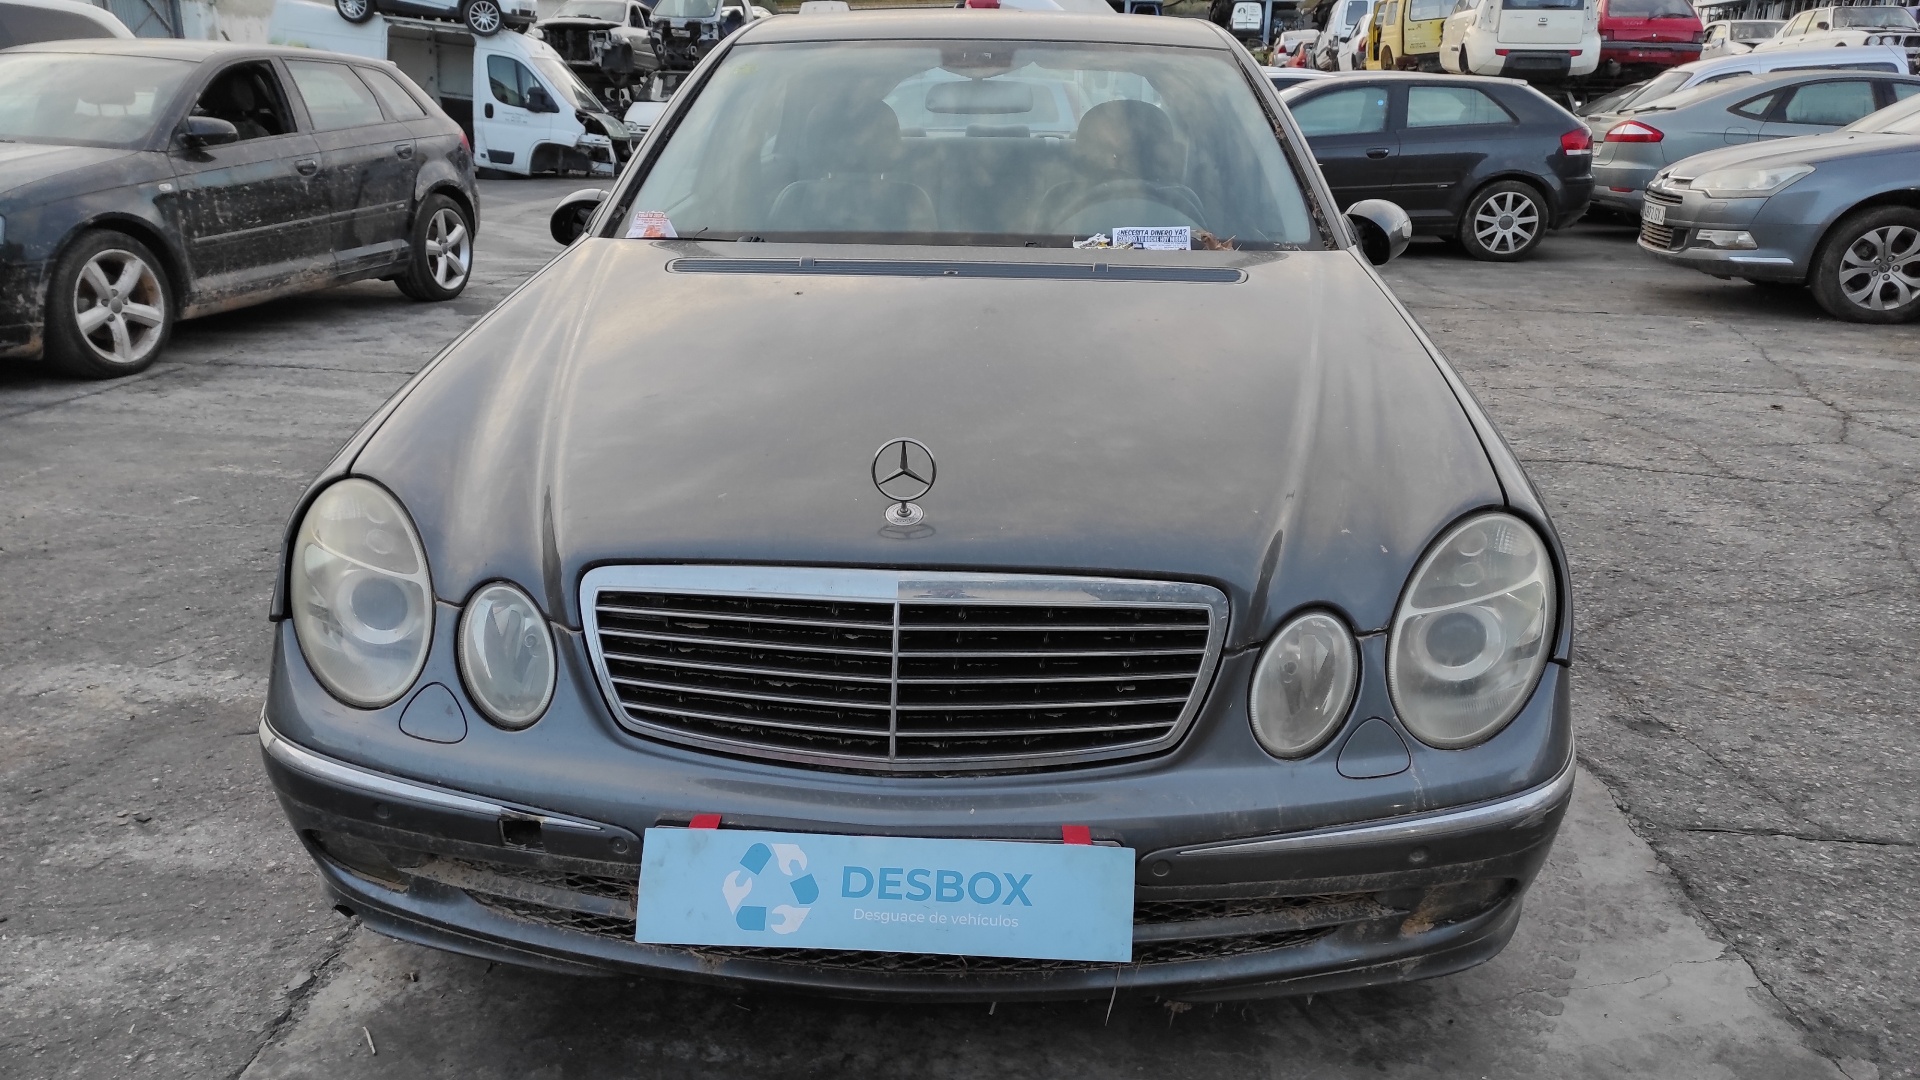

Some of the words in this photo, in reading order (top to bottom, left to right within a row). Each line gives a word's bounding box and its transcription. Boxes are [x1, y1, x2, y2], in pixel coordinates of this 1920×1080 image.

[842, 865, 1033, 906] DESBOX
[853, 908, 925, 924] Desguace
[929, 912, 947, 924] de
[951, 912, 1019, 928] vehículos
